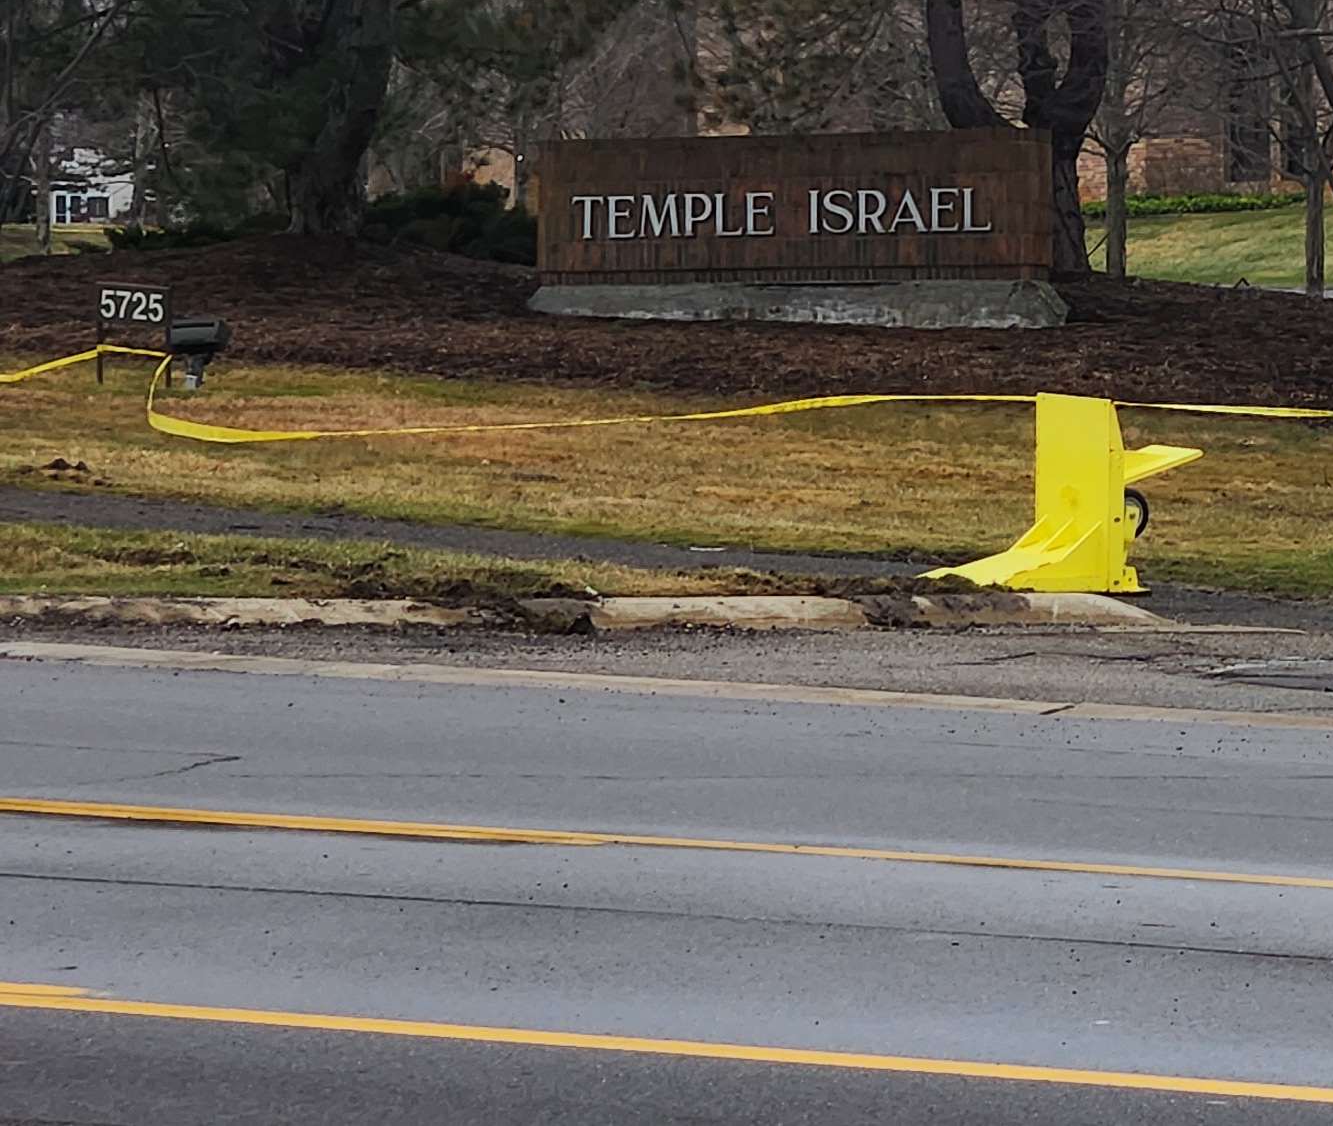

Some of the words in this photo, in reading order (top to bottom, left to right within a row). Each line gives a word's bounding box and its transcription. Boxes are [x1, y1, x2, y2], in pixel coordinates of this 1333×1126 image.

[571, 191, 774, 240] TEMPLE
[808, 187, 993, 235] ISRAEL
[101, 289, 164, 322] 5725
